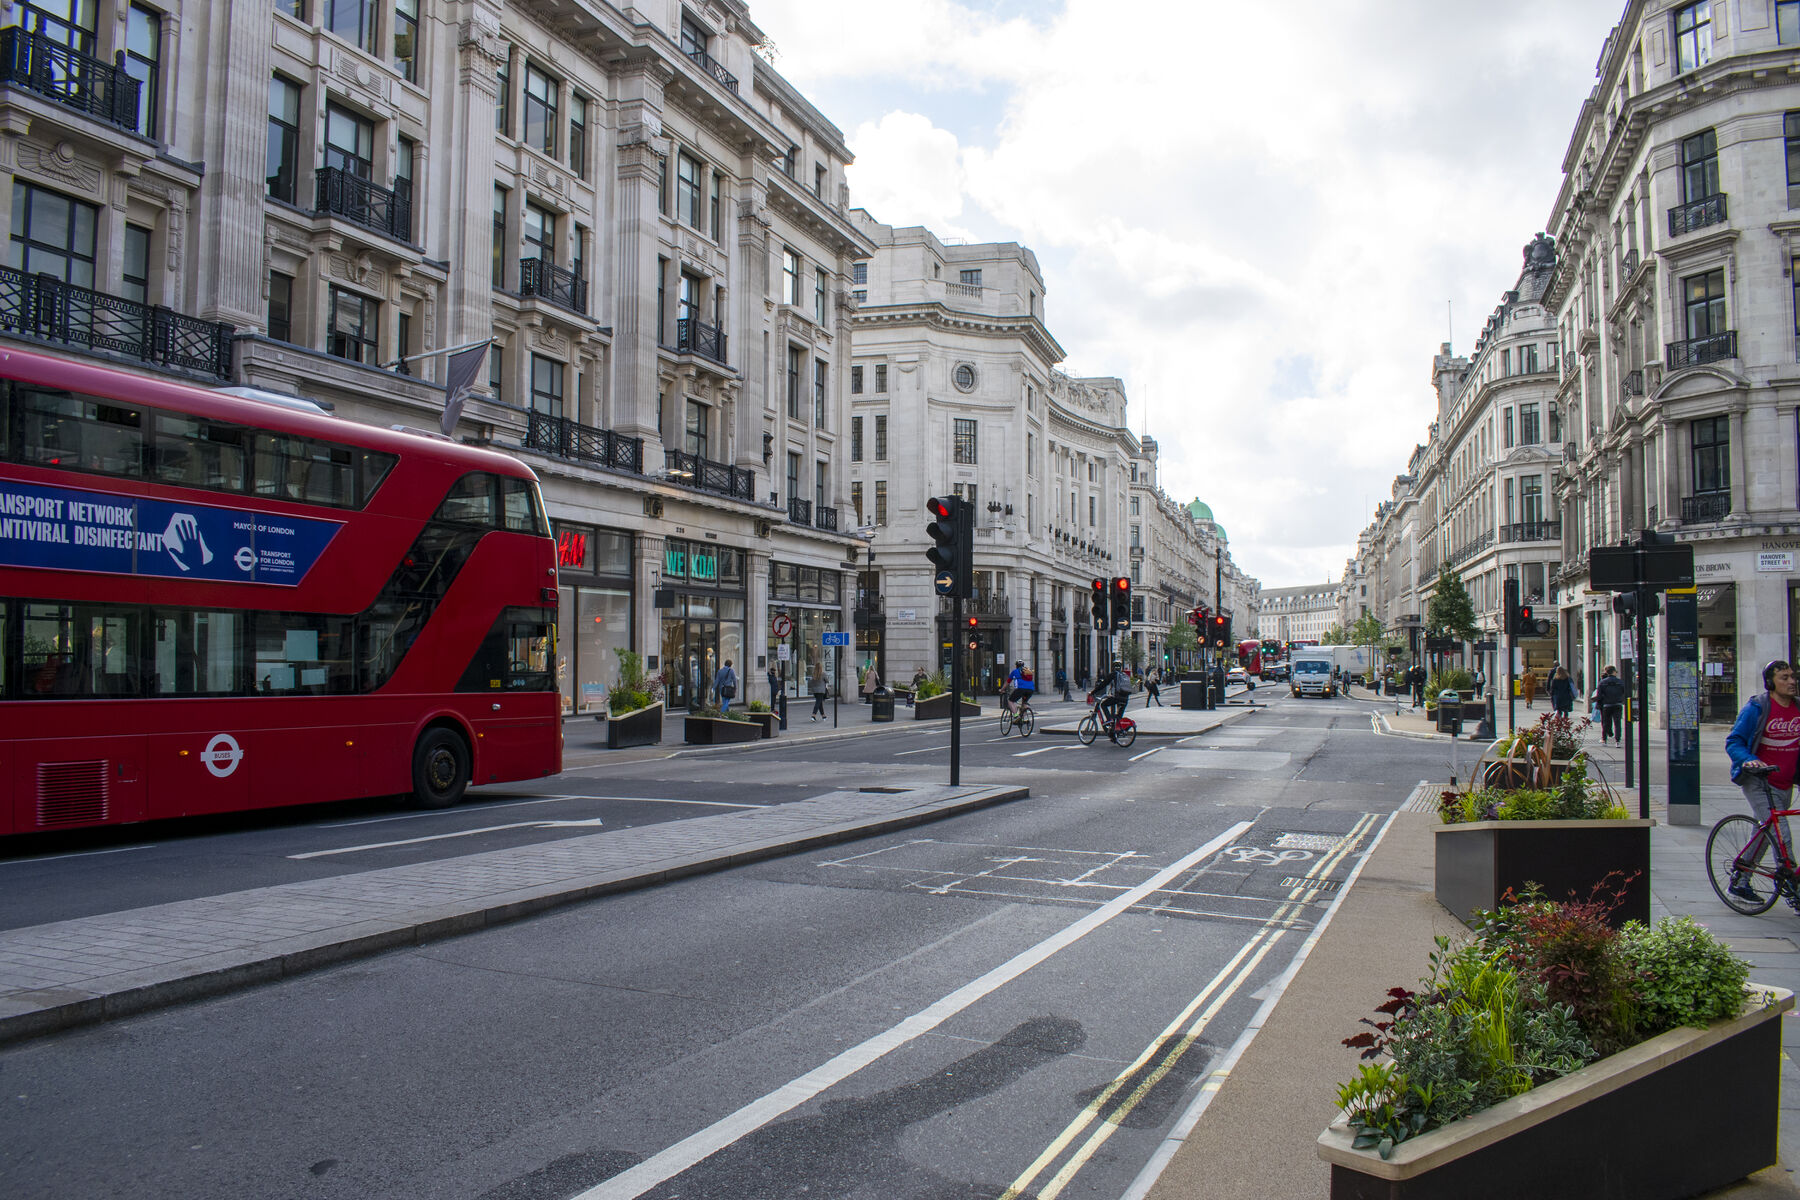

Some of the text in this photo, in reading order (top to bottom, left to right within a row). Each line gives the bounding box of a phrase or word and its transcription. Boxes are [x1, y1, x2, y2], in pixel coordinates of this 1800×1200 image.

[69, 501, 134, 527] NETWORK
[233, 522, 295, 535] MAYOR OF LONDON
[74, 525, 163, 552] DISINFECTANT
[260, 550, 291, 558] TRANSPORT
[558, 530, 587, 568] H&M
[272, 558, 295, 566] LONDON
[1705, 562, 1731, 572] BROWN
